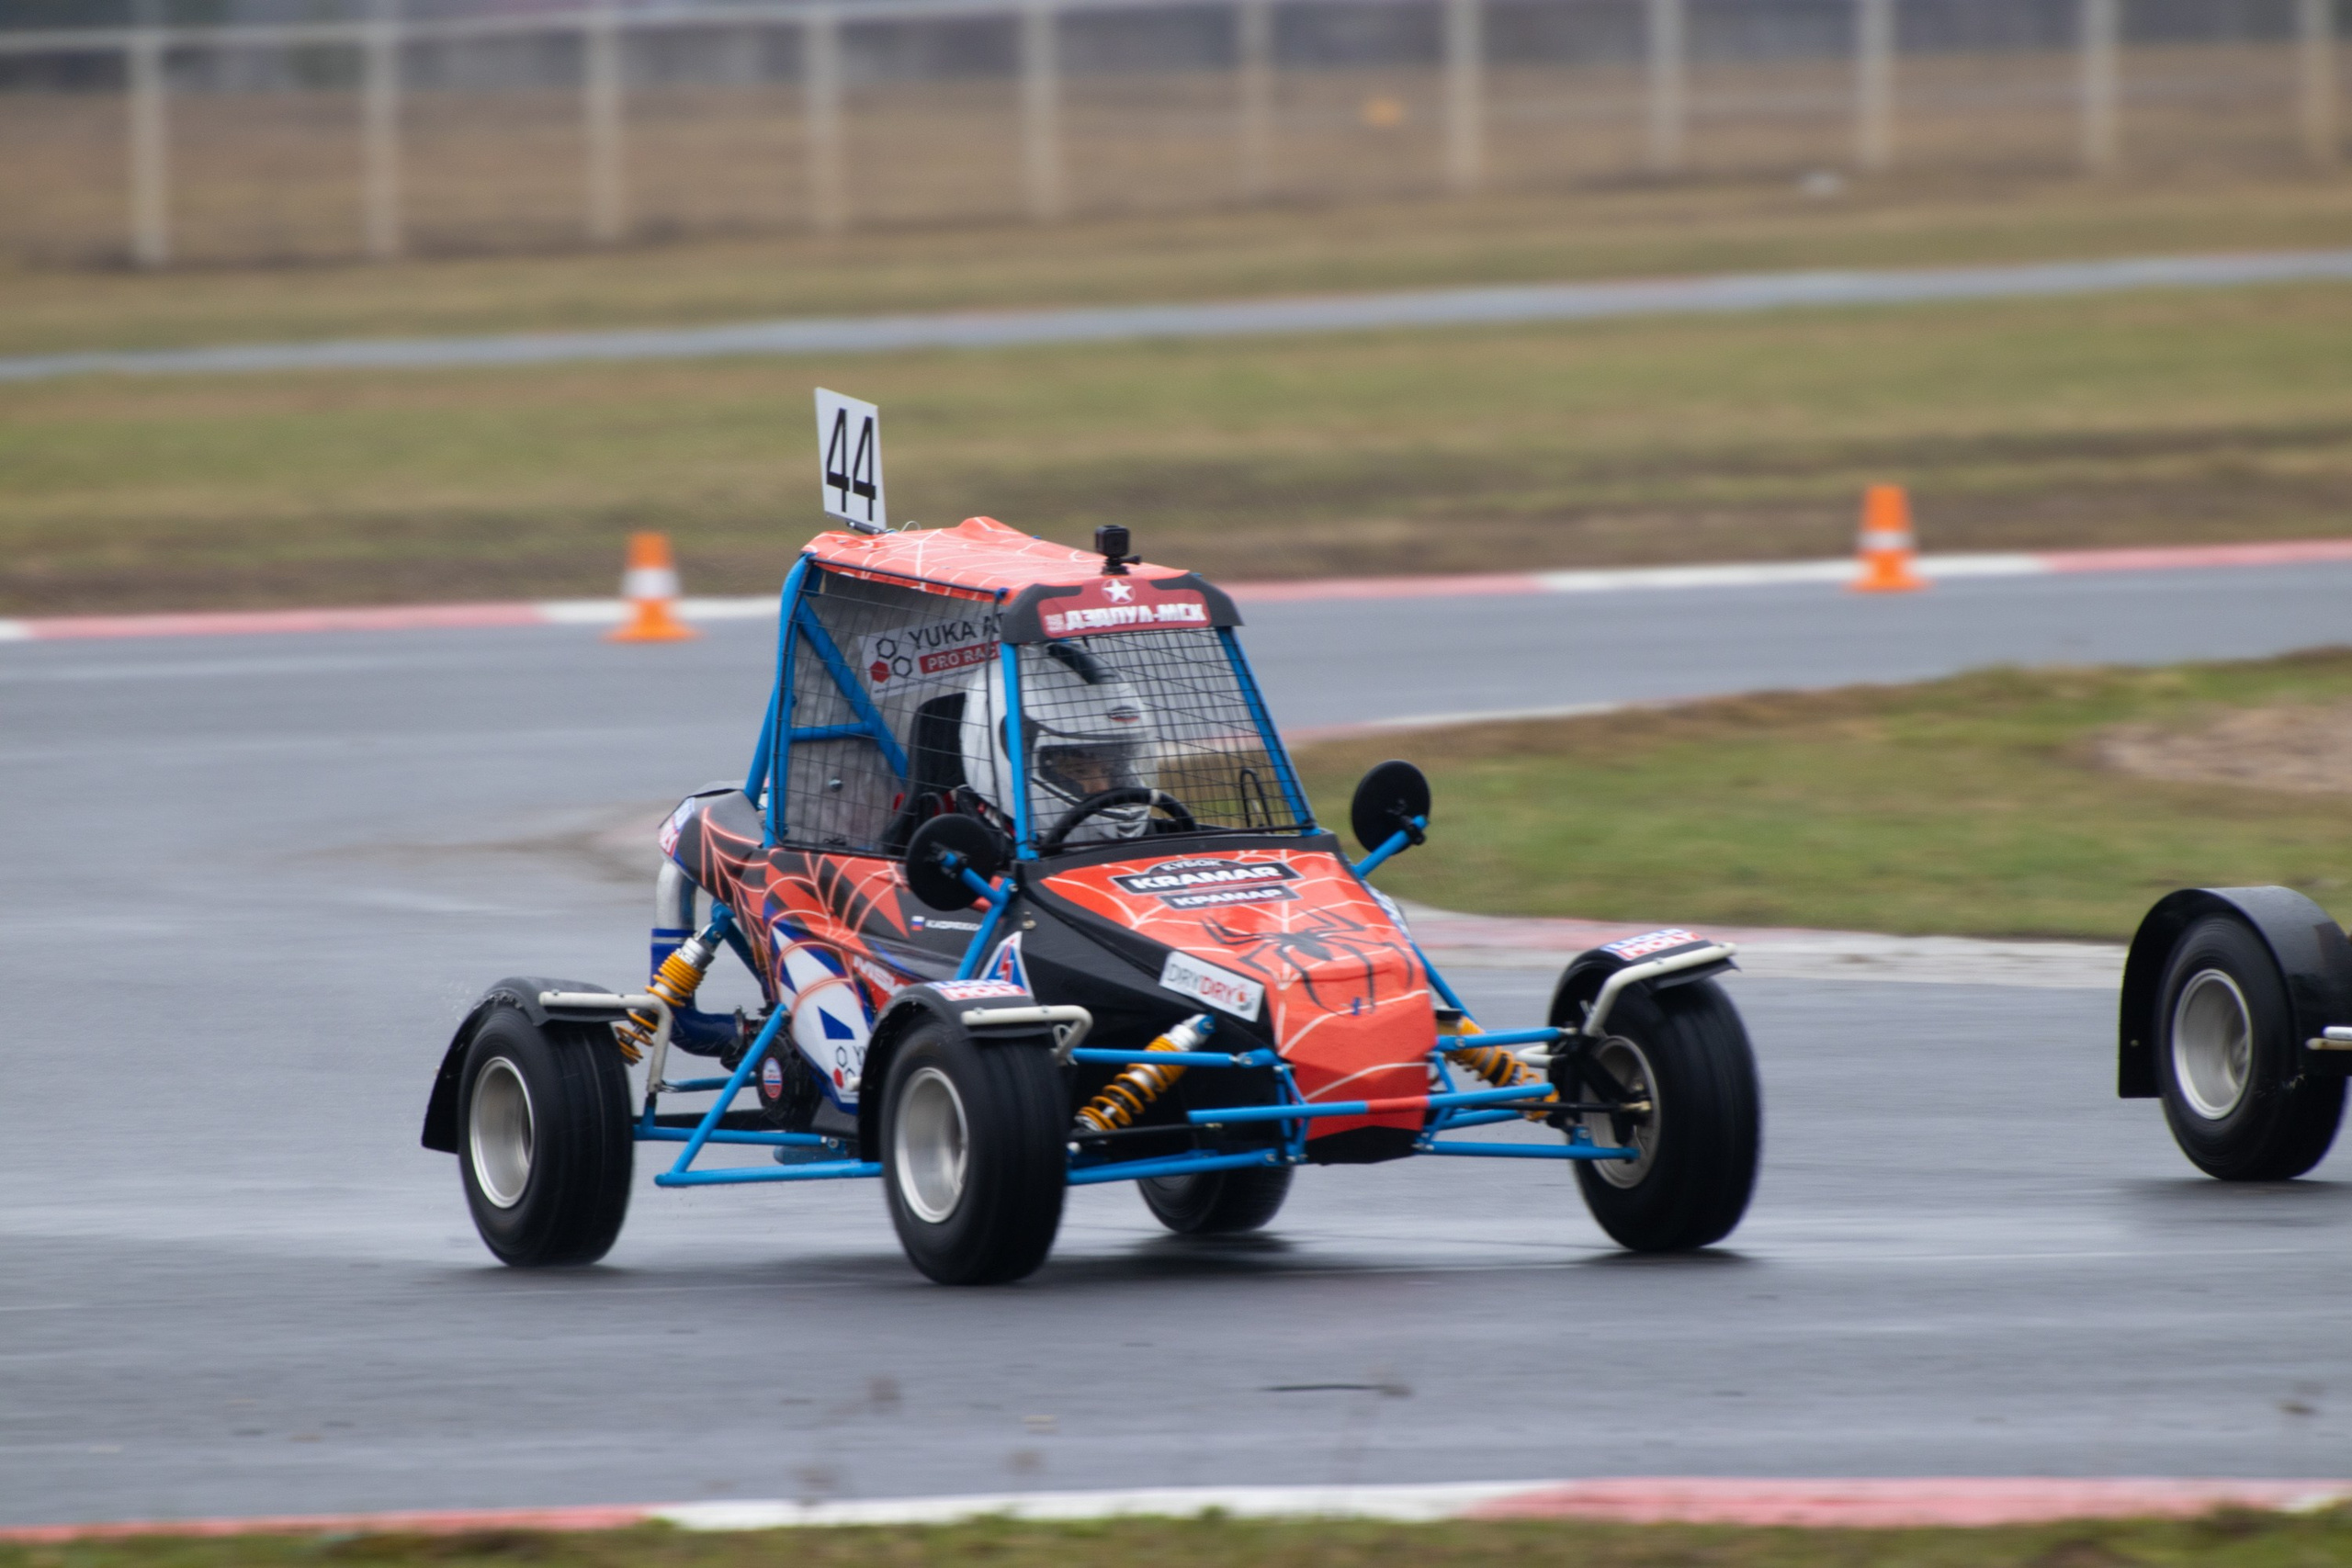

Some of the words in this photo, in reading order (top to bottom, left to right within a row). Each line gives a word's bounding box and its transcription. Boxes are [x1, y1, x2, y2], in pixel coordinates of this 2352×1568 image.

[826, 407, 876, 522] 44
[908, 621, 978, 650] YUKA
[926, 652, 960, 671] PRO
[1128, 865, 1281, 890] KRAMAR
